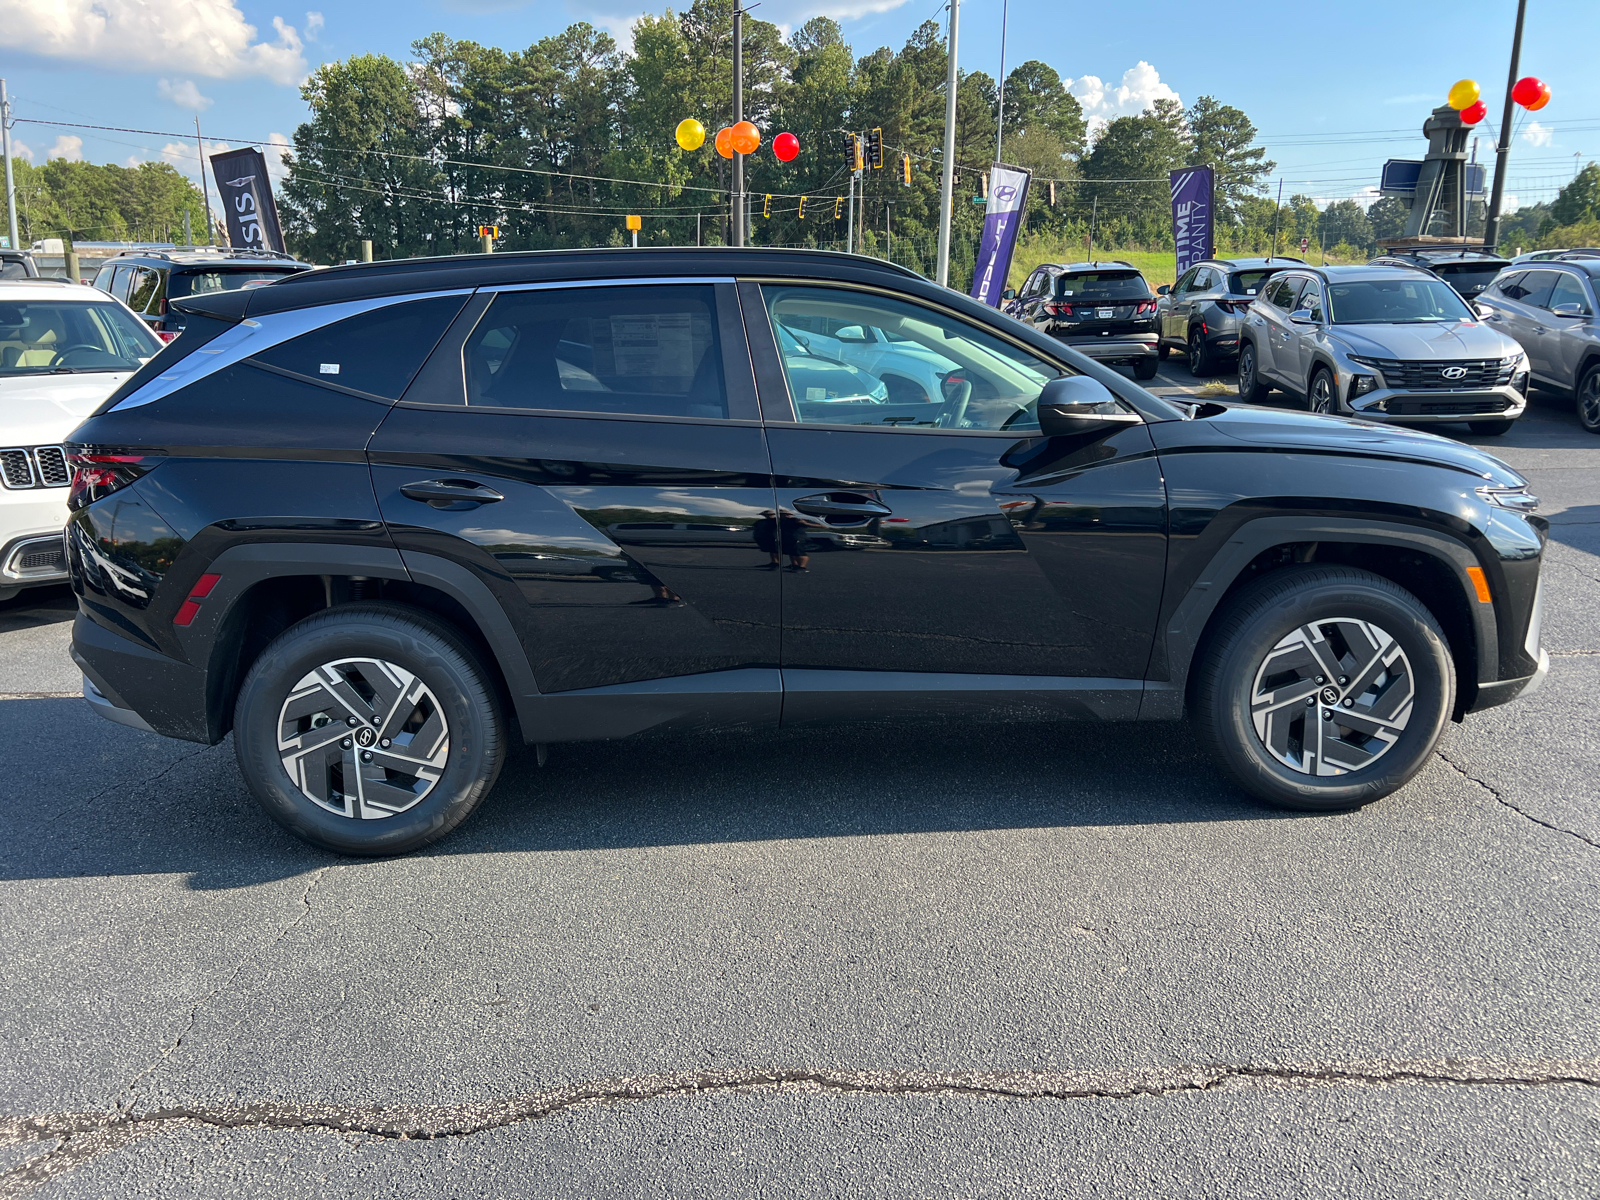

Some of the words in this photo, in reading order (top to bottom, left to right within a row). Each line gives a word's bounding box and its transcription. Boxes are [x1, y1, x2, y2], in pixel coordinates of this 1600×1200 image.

[1176, 201, 1191, 276] ETIME
[1192, 200, 1206, 263] RANTY
[446, 684, 472, 769] NEXEN
